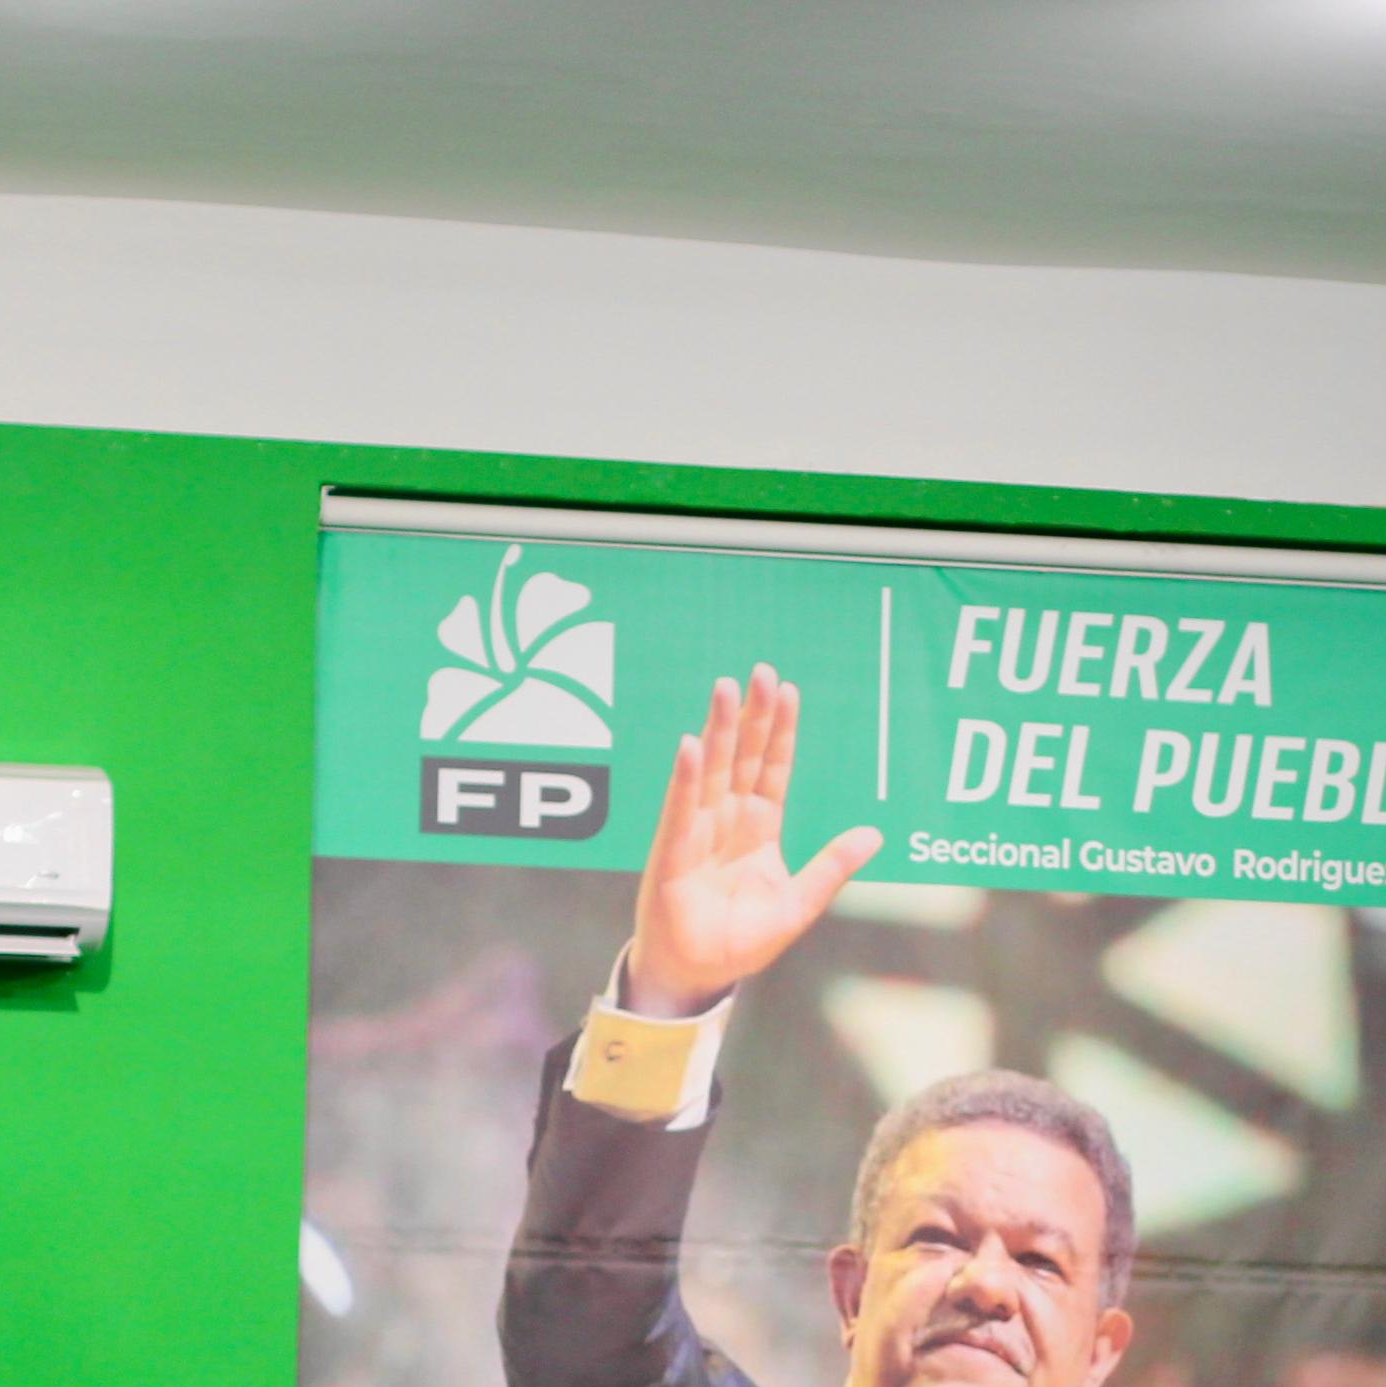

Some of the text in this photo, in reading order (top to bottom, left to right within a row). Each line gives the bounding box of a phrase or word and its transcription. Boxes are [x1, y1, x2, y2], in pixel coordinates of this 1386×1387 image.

[946, 604, 1273, 707] FUERZA
[436, 767, 594, 829] FP
[945, 717, 1102, 810] DEL
[908, 831, 1072, 872] Seccional
[1078, 839, 1217, 879] Gustavo
